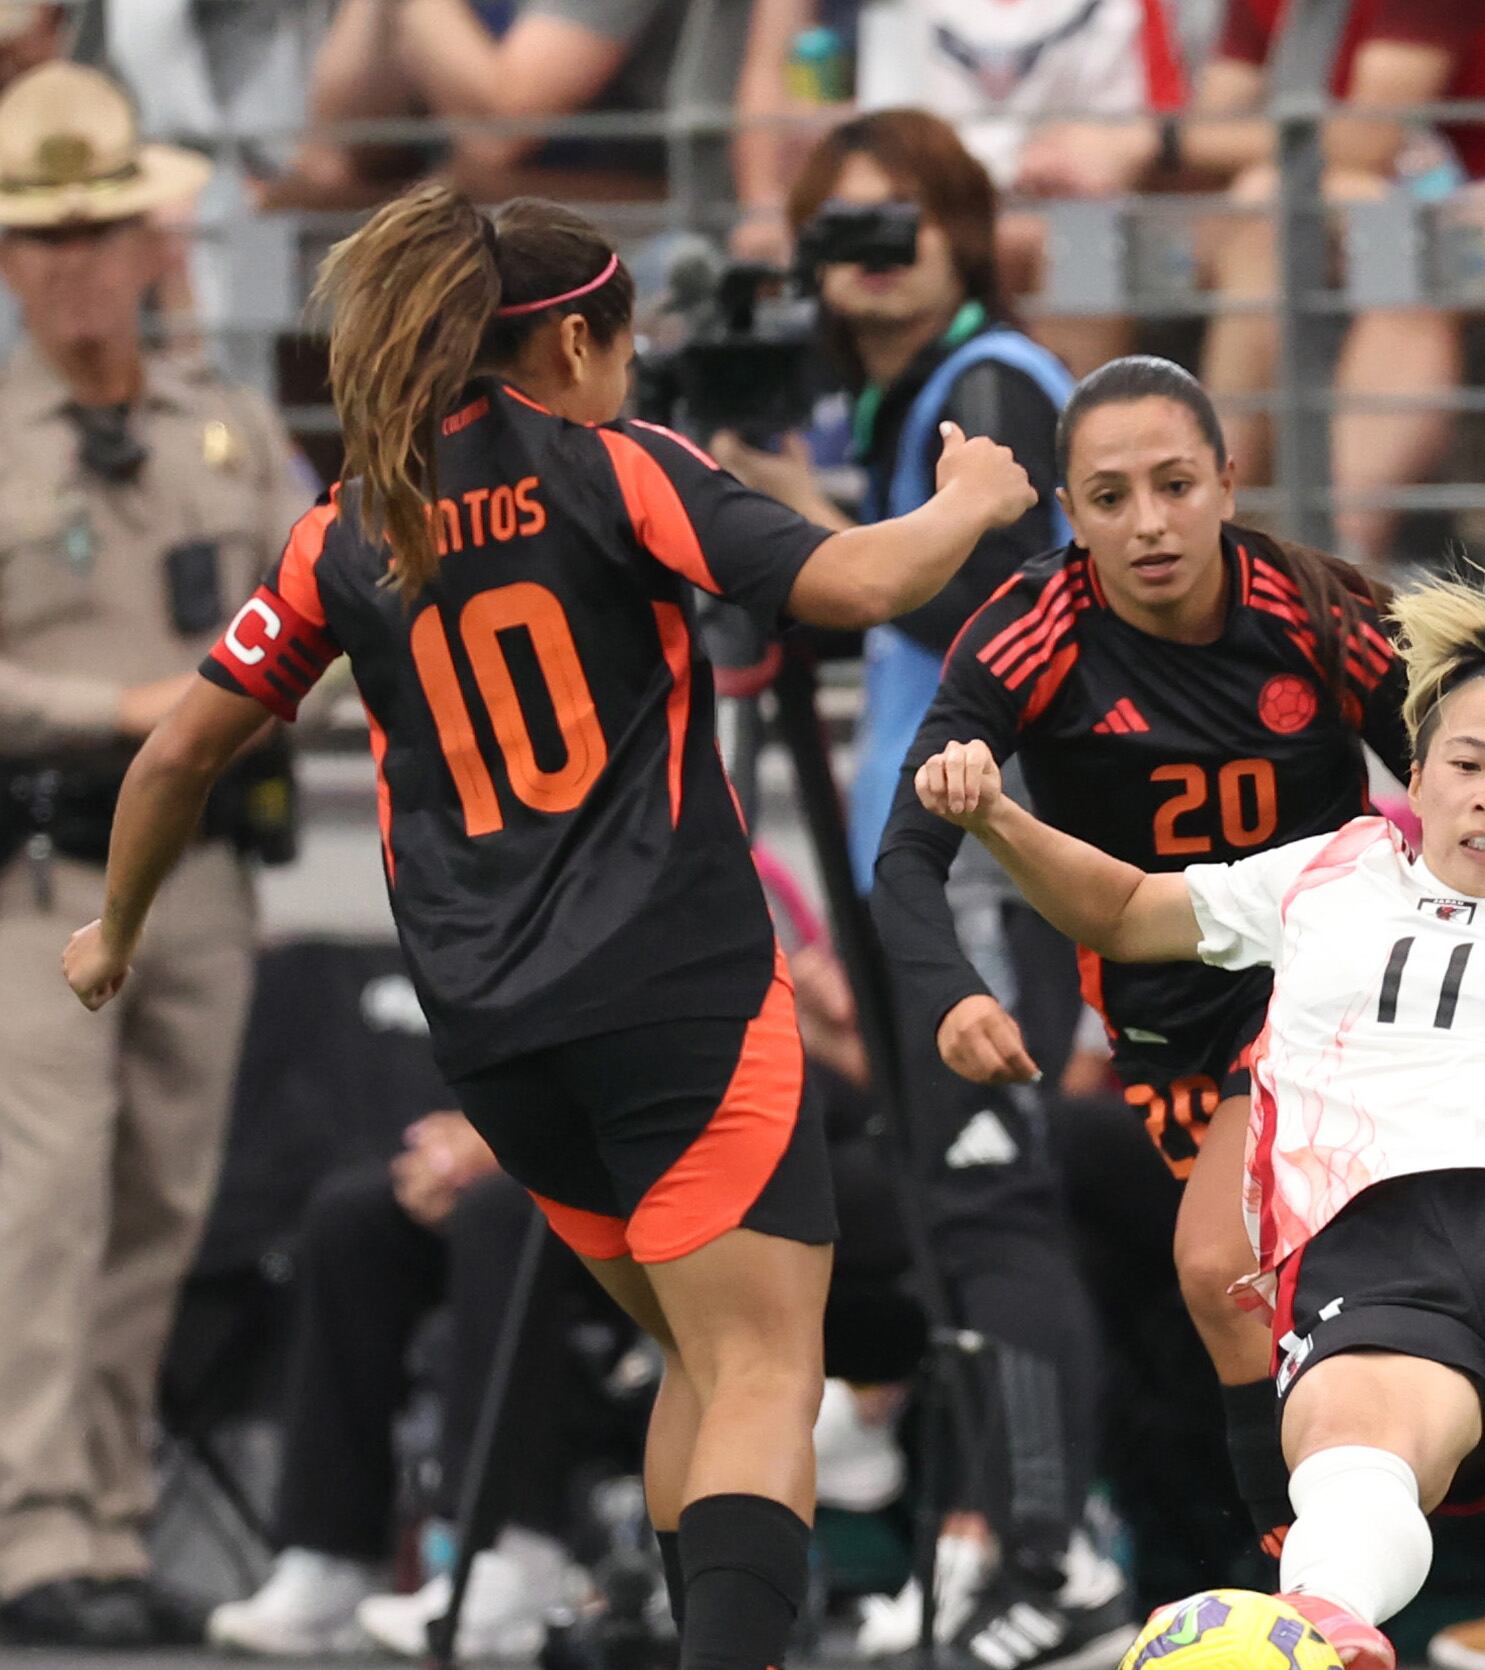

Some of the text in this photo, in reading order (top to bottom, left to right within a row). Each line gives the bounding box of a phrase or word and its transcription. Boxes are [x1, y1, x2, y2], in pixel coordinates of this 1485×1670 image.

[224, 597, 281, 665] C
[410, 581, 608, 837] 10
[1150, 758, 1278, 856] 20
[1377, 936, 1474, 1030] 11
